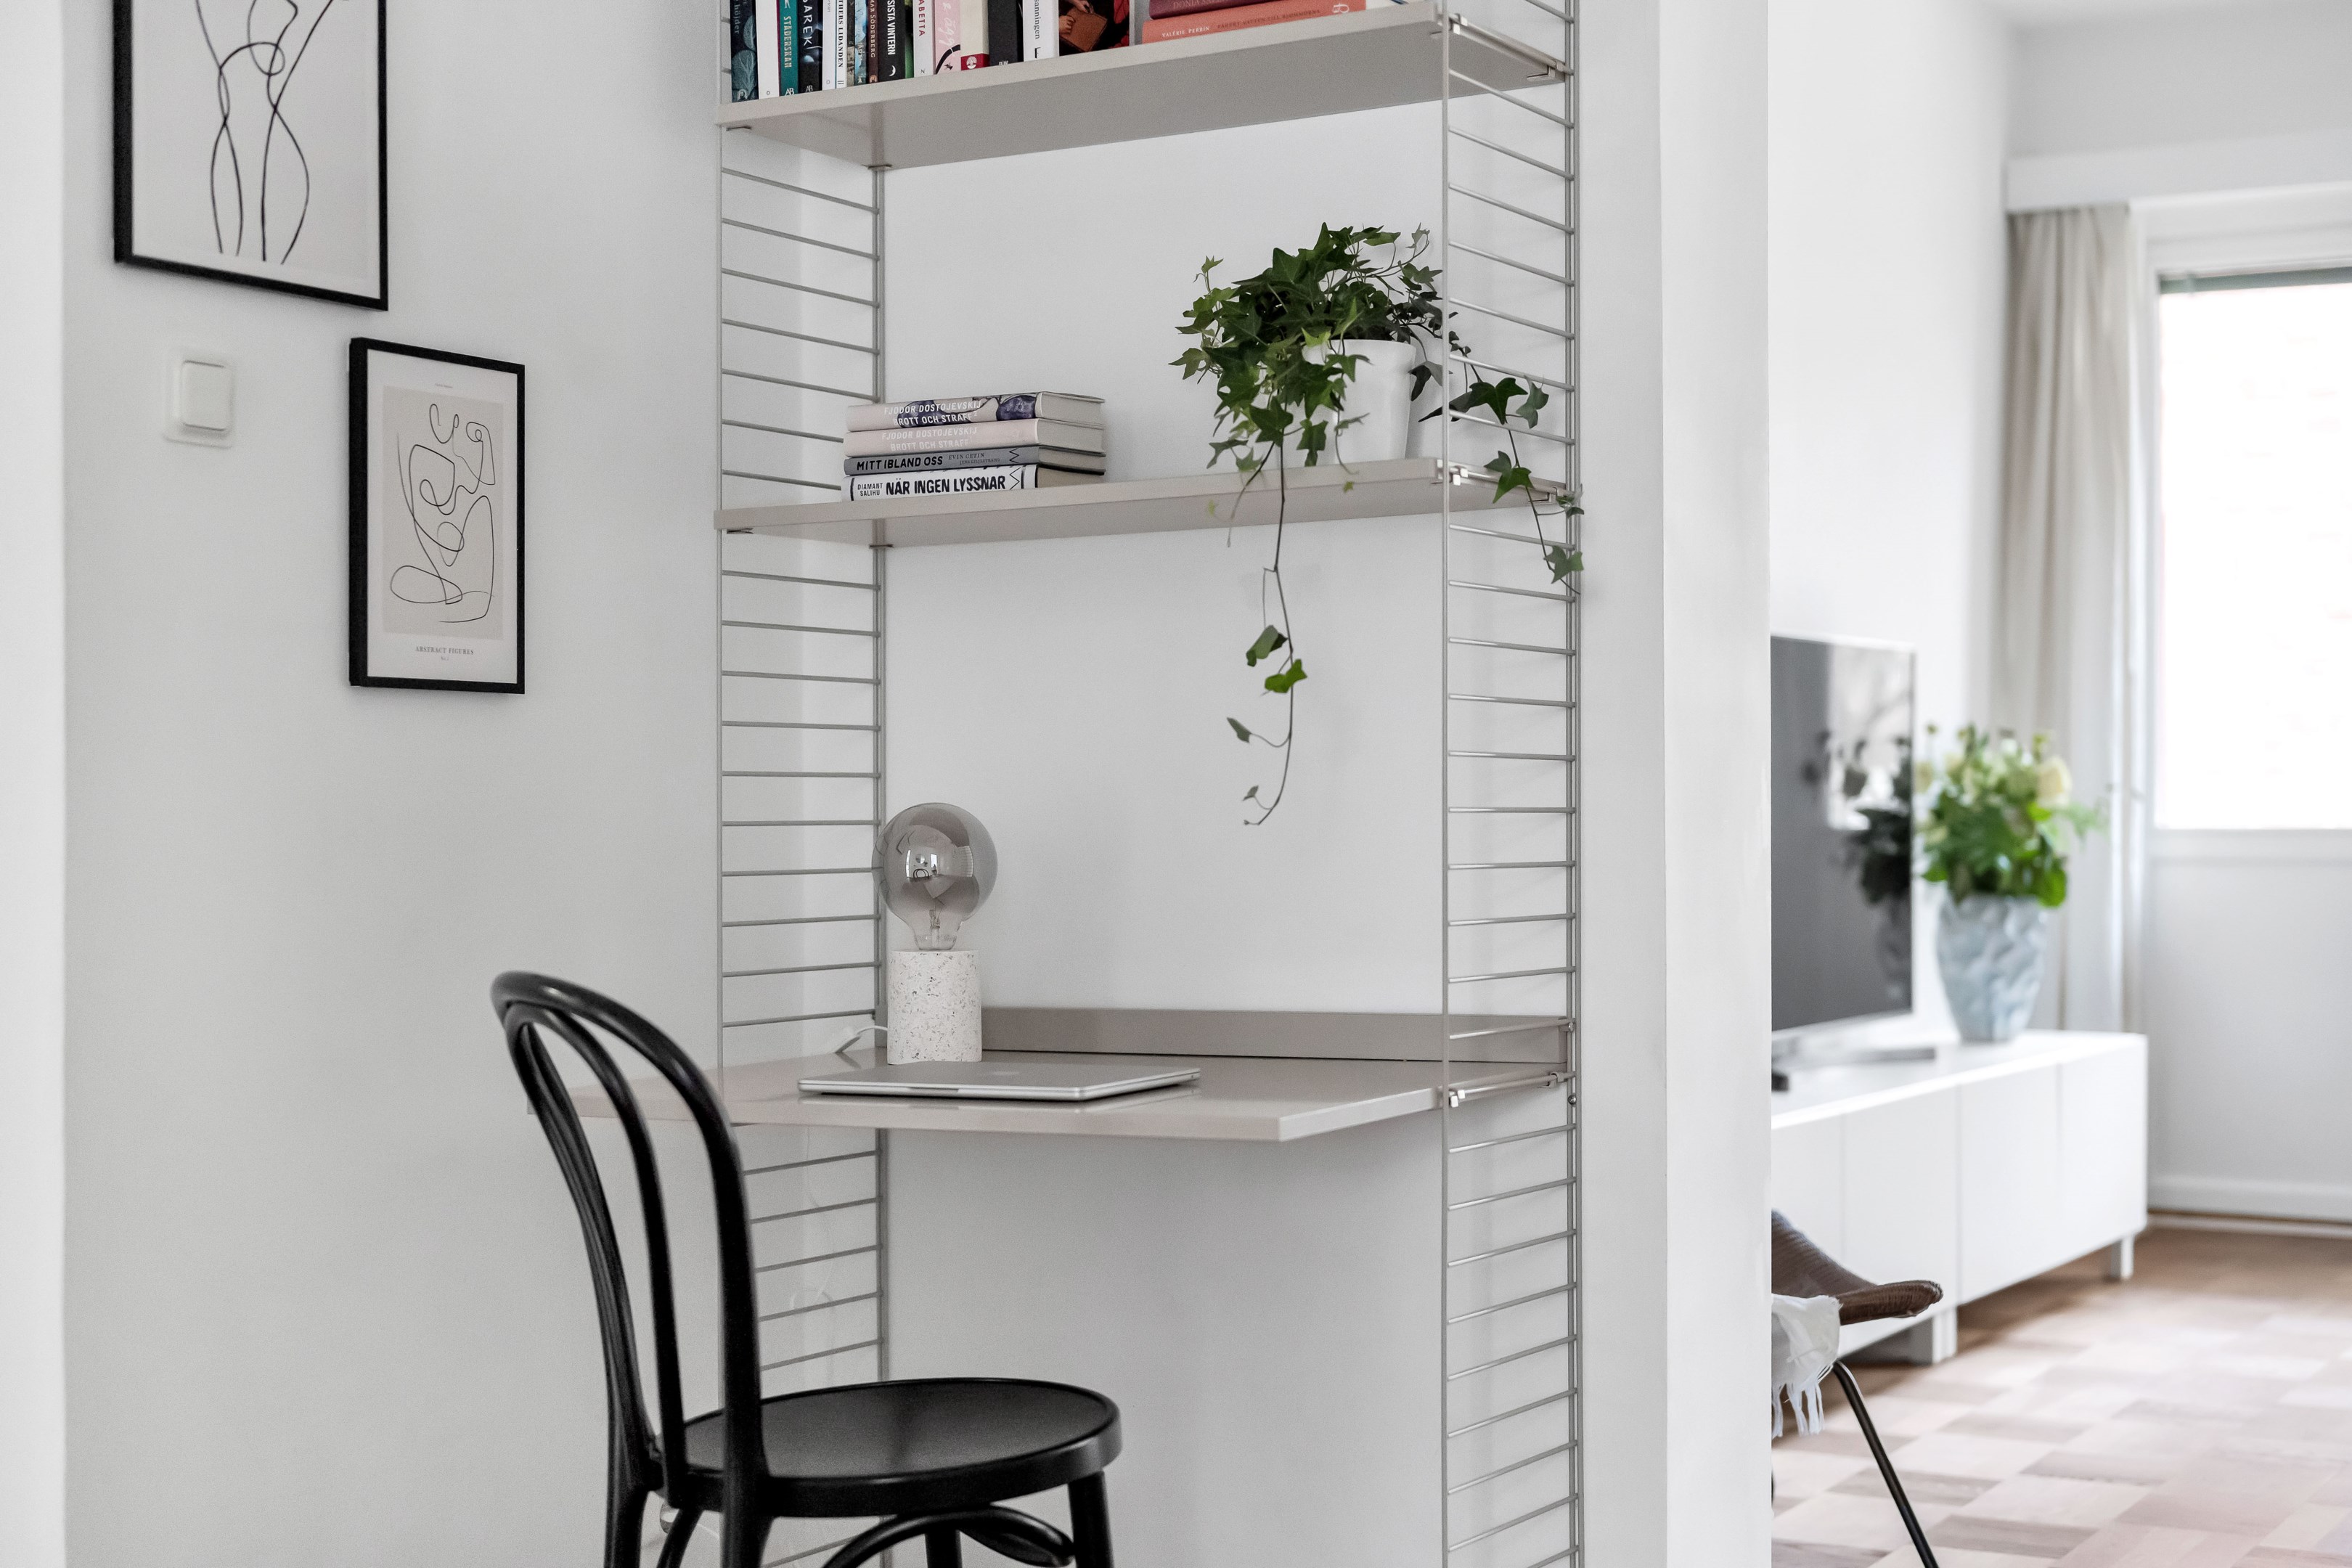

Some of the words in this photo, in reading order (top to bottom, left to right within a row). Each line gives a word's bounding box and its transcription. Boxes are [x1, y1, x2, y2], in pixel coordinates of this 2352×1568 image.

[887, 23, 896, 55] VINTERN
[1162, 29, 1185, 38] VALÉRIE
[784, 16, 793, 68] STÄDERSKAN
[883, 404, 915, 415] FJODOR
[918, 401, 981, 413] DOSTOJEVSKIJ
[892, 417, 919, 427] BROTT
[921, 415, 939, 424] OCH
[942, 412, 972, 423] STRAFF
[882, 430, 913, 441] FJODOR
[915, 426, 978, 438] DOSTOJEVSKIJ
[891, 442, 917, 452] BROTT
[919, 441, 936, 450] OCH
[939, 438, 969, 449] STRAFF
[857, 460, 882, 471] MITT
[883, 457, 921, 469] IBLAND
[923, 455, 943, 466] OSS
[886, 478, 910, 496] NÄR
[914, 478, 950, 494] INGEN
[953, 475, 1006, 492] LYSSNAR
